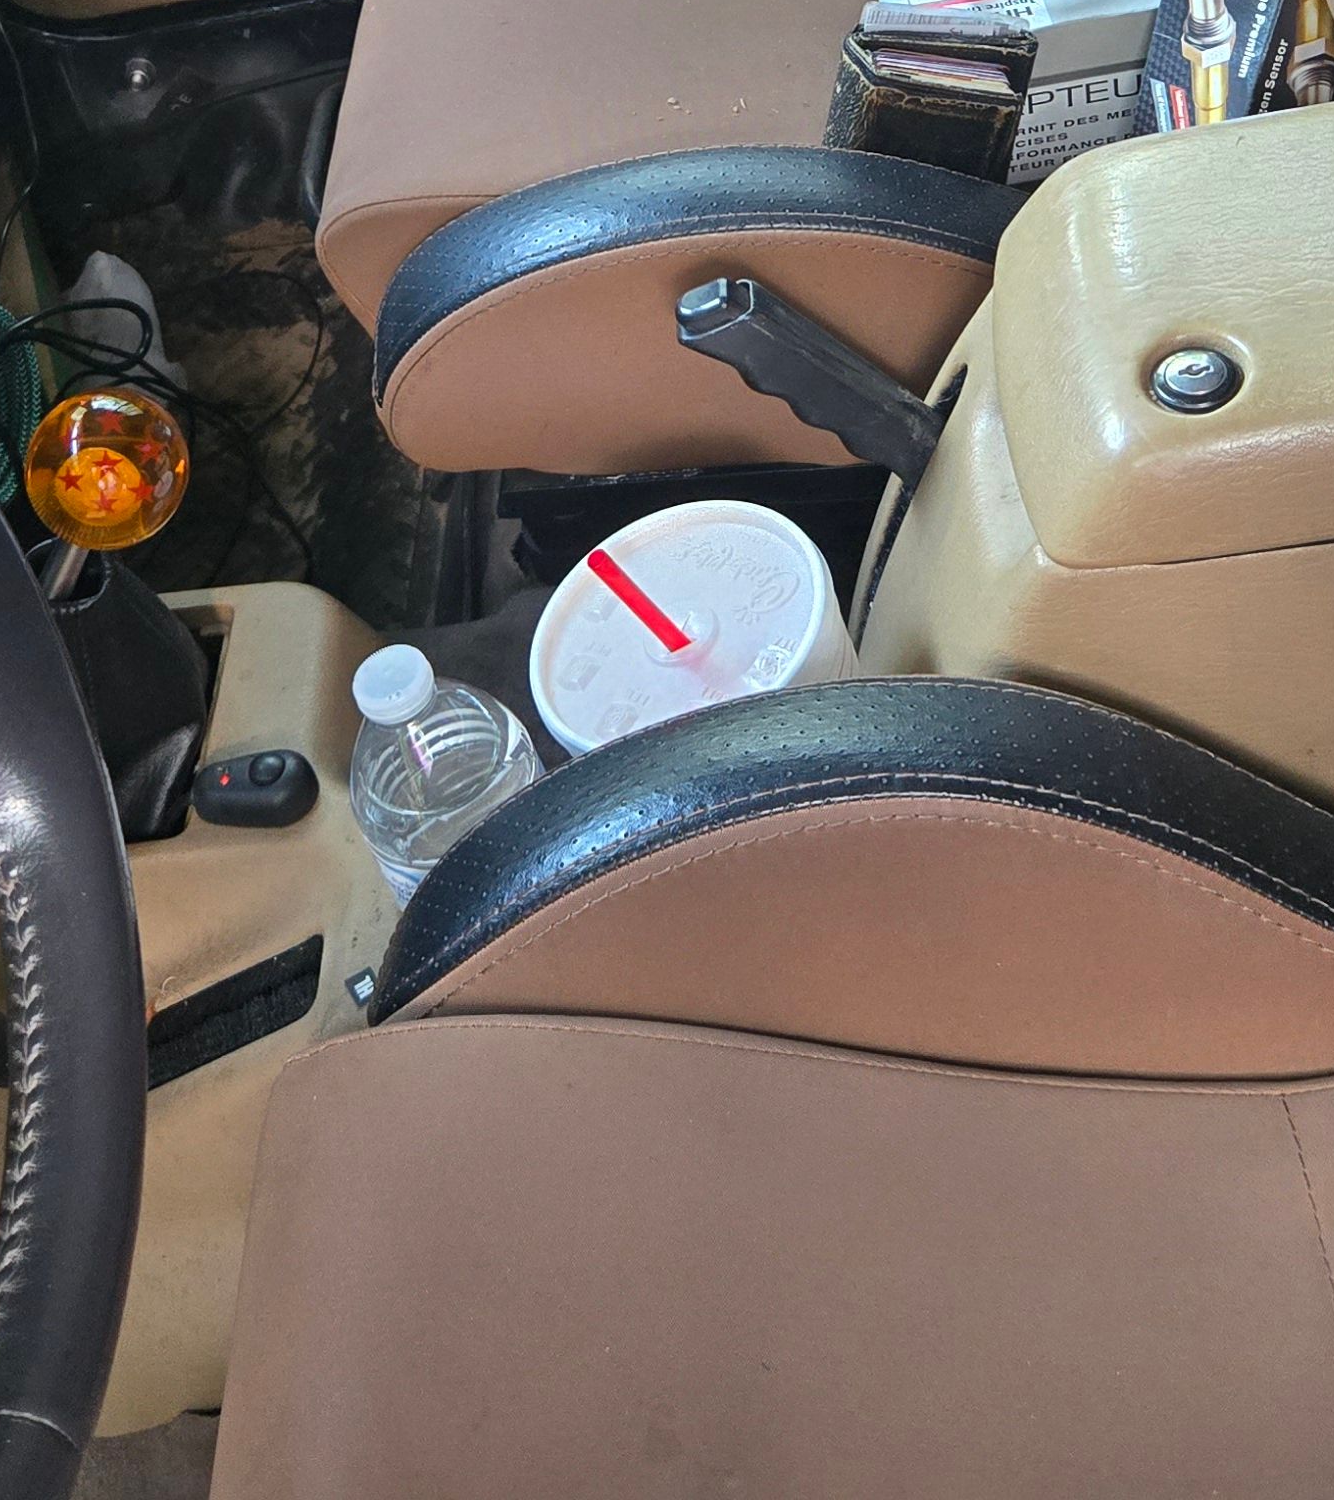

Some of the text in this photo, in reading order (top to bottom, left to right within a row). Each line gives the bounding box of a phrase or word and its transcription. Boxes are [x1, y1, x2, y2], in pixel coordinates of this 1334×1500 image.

[1238, 12, 1267, 79] Premium
[1265, 38, 1289, 88] Sensor
[1064, 116, 1100, 128] DES
[1107, 108, 1137, 121] ME
[1010, 134, 1117, 161] FORMANCE
[1015, 132, 1069, 148] CISES
